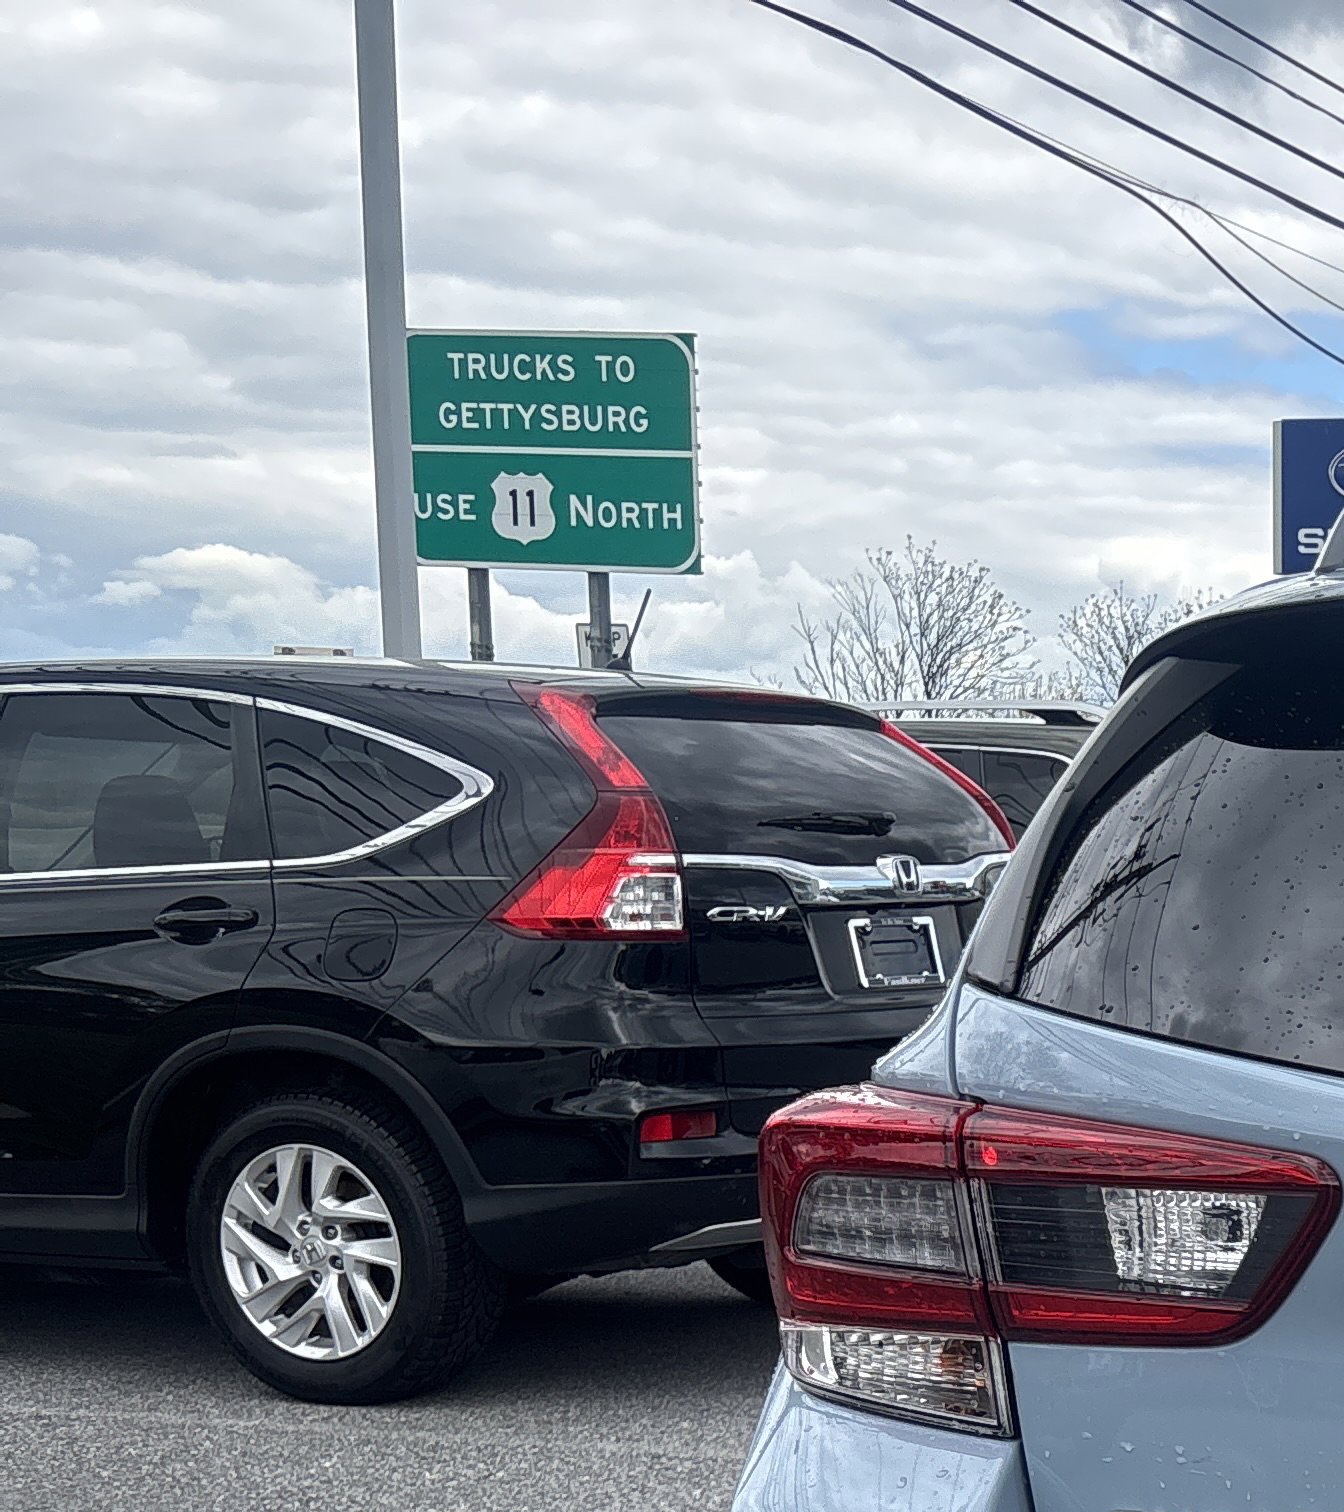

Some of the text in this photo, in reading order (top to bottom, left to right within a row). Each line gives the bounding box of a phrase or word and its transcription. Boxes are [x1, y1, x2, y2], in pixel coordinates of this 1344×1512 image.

[447, 352, 635, 383] TRUCKS TO
[438, 401, 649, 433] GETTYSBURG
[413, 489, 683, 530] USE 11 NORTH
[706, 906, 788, 922] CR-V
